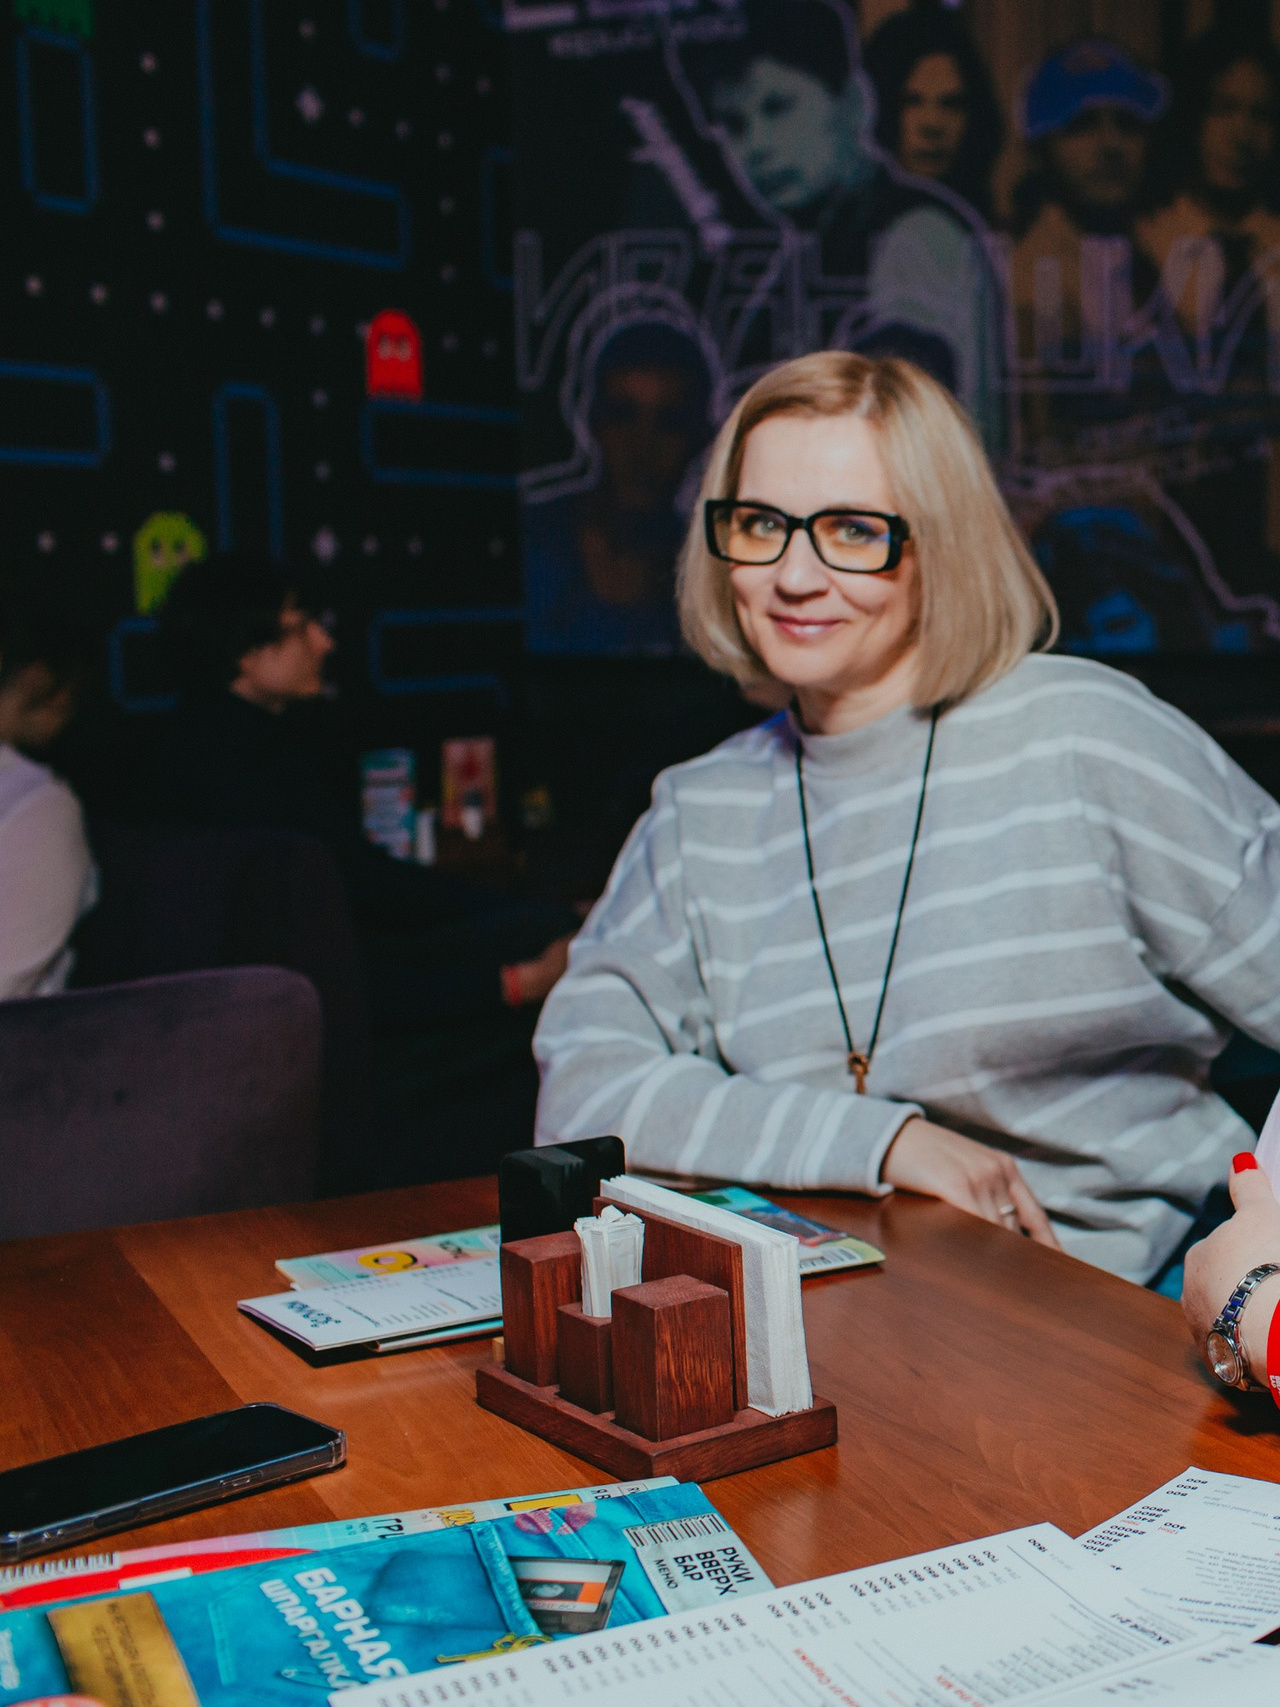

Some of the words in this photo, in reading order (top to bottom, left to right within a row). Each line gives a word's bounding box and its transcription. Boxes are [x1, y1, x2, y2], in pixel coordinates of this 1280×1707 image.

[654, 1559, 679, 1590] МЕНЮ
[673, 1554, 704, 1582] БАР
[696, 1551, 738, 1596] ВВЕРХ
[717, 1546, 755, 1584] РУКИ
[294, 1567, 410, 1678] БАРНАЯ
